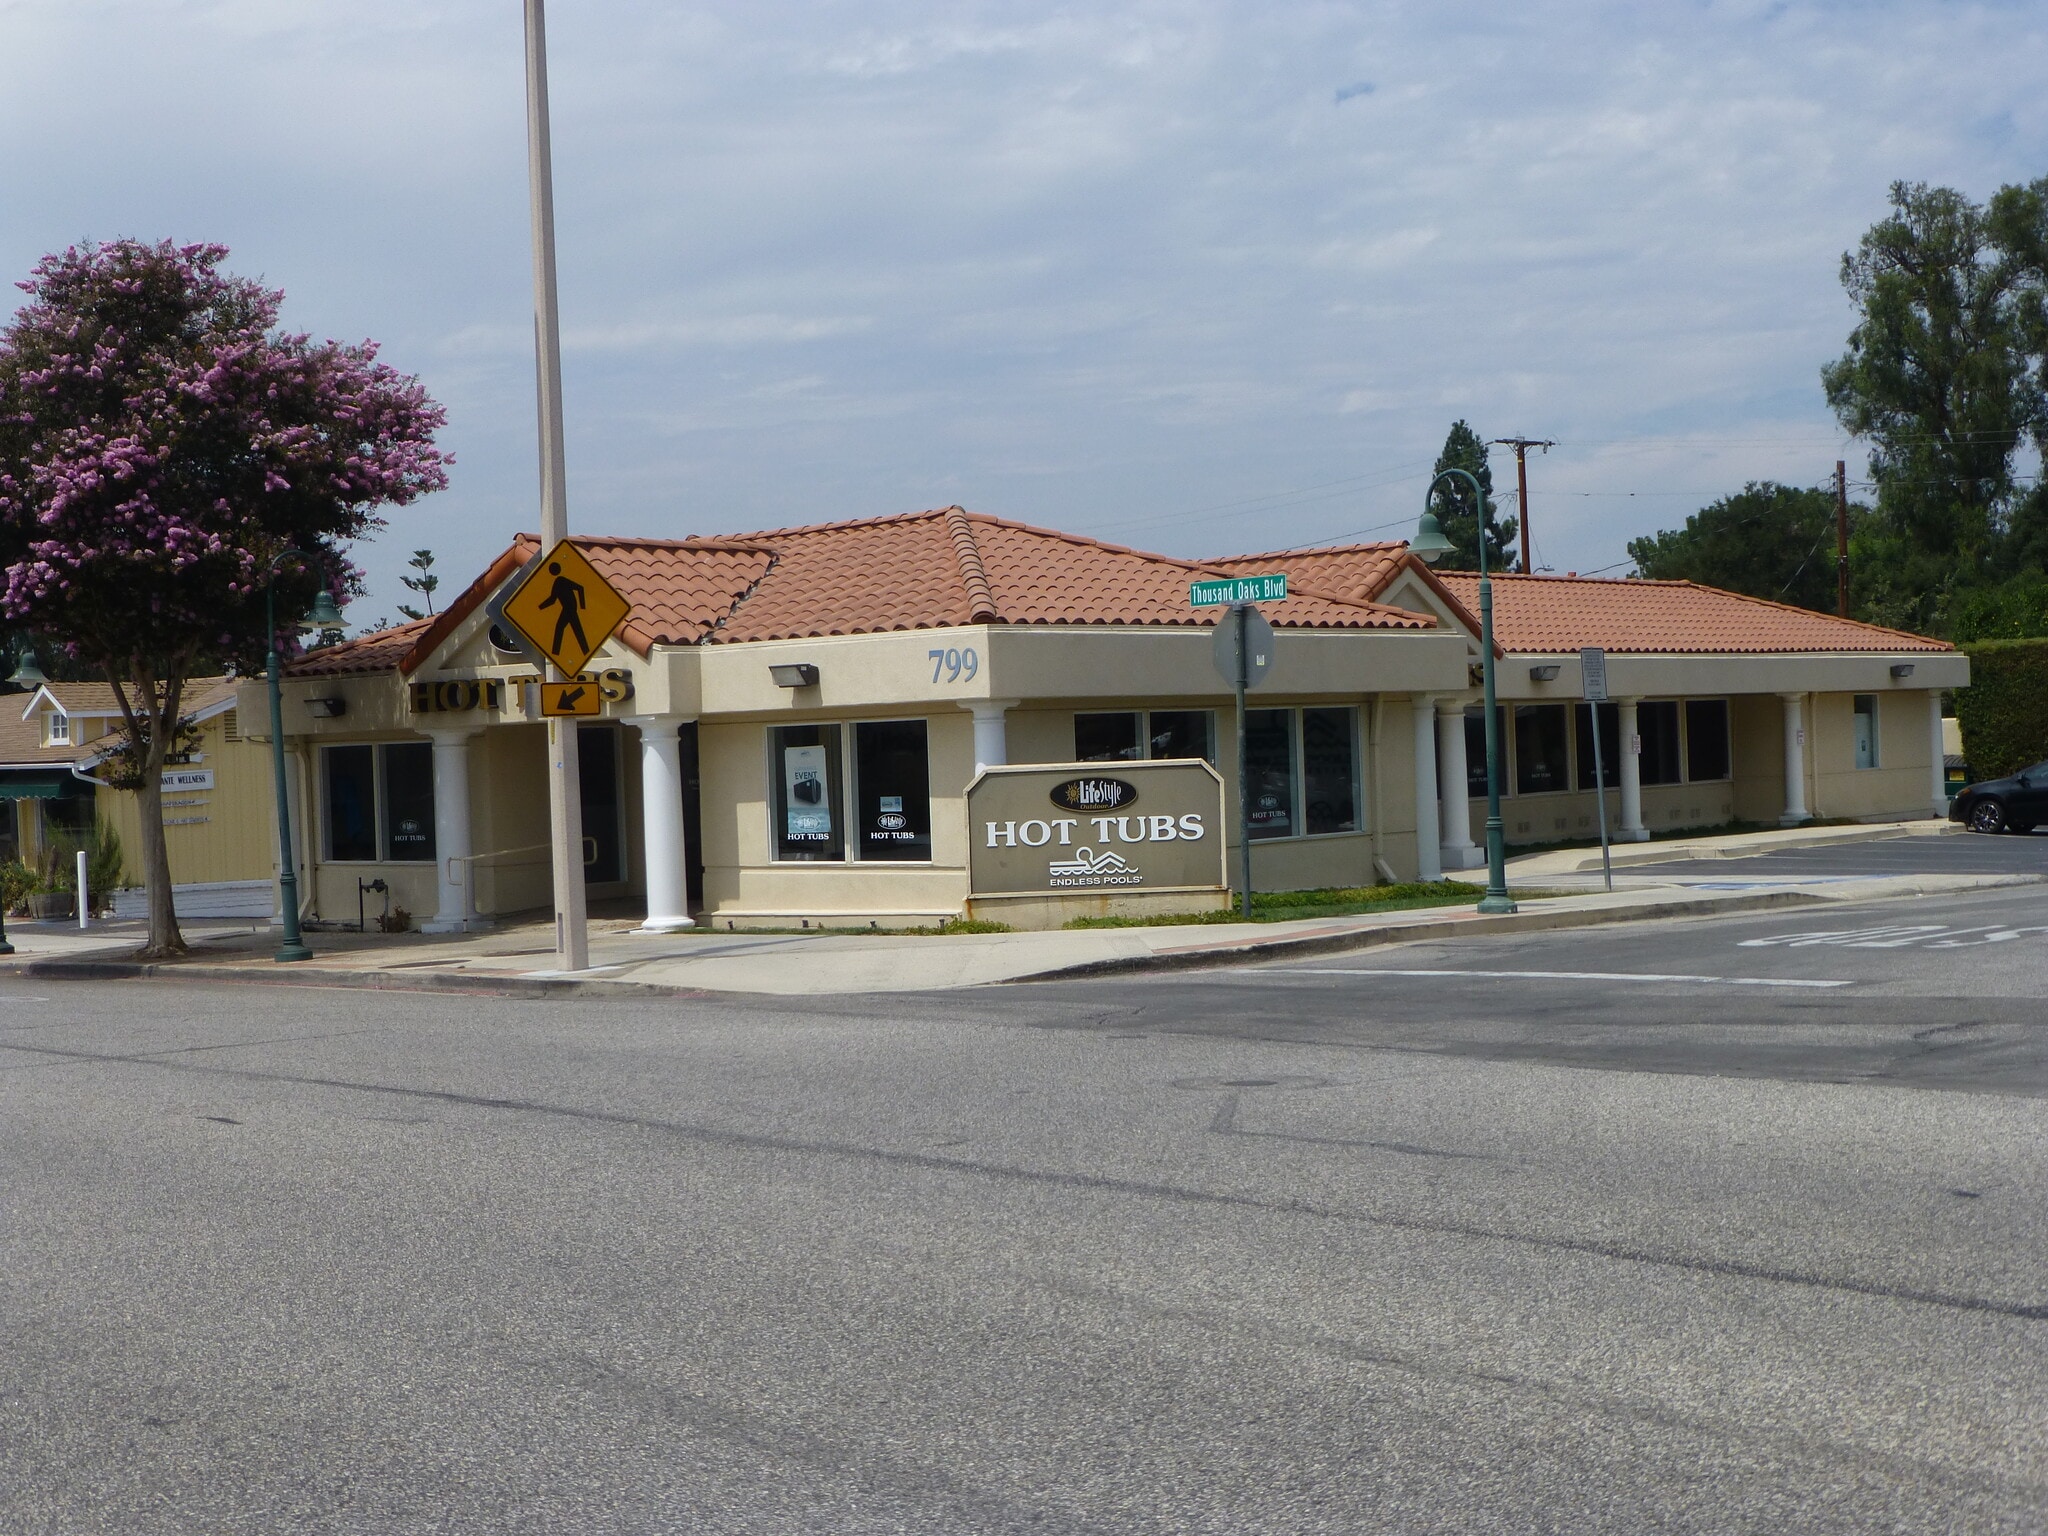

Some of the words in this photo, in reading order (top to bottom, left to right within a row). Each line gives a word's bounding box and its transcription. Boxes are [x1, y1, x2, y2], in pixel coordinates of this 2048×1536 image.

[1192, 582, 1233, 604] Thousand
[1237, 581, 1260, 600] Oaks
[1264, 578, 1284, 598] Blvd
[928, 647, 978, 684] 799
[410, 678, 502, 713] HOT
[508, 667, 634, 710] TS
[177, 774, 206, 784] WELLNESS
[794, 771, 818, 780] EVENT
[1252, 811, 1267, 819] HOT
[870, 832, 889, 840] HOT
[891, 831, 915, 840] TUBS
[985, 819, 1078, 849] HOT
[1090, 813, 1205, 844] TUBS
[787, 832, 806, 841] HOT
[807, 832, 829, 840] TUBS
[1050, 876, 1101, 887] ENDLESS
[1103, 876, 1142, 886] POOLS
